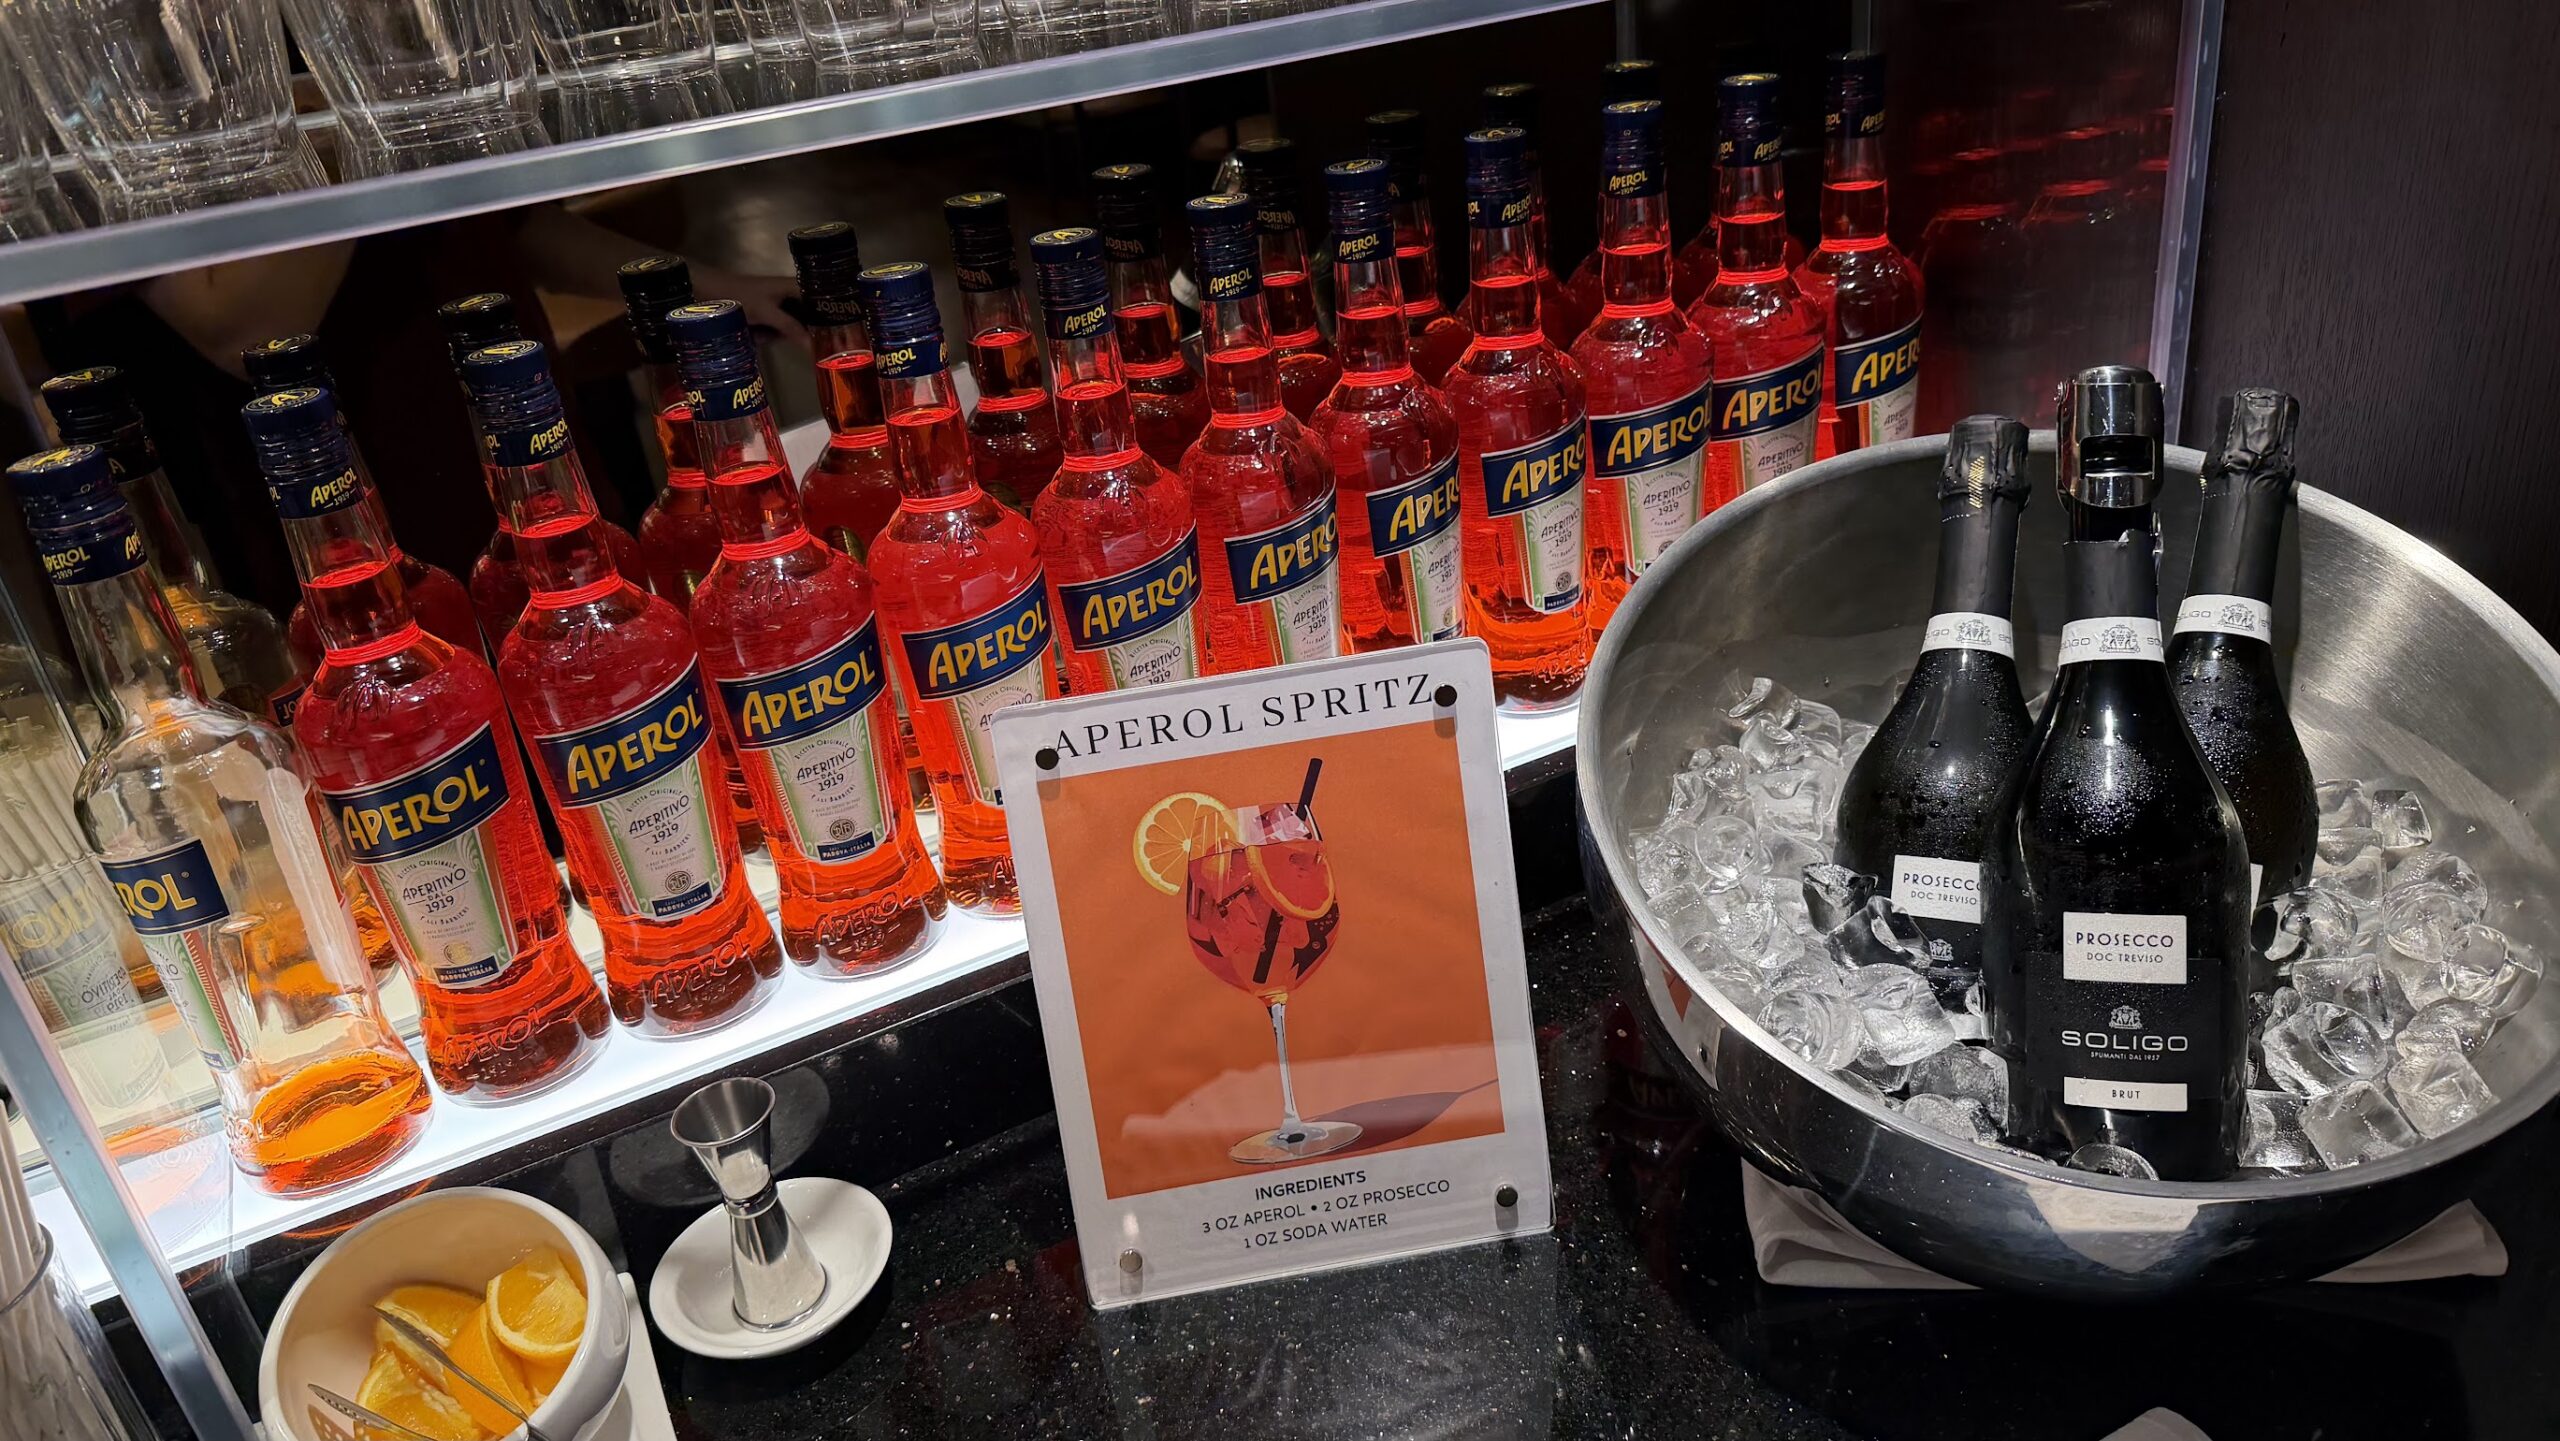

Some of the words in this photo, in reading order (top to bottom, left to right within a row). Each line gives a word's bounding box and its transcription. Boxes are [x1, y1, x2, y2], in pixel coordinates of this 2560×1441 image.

[1609, 170, 1648, 191] APEROL
[1339, 233, 1380, 257] APEROL
[1210, 268, 1253, 294] APEROL
[1064, 304, 1107, 333] APEROL
[876, 347, 916, 370] APEROL
[1851, 337, 1919, 394] APER
[530, 417, 568, 455] APEROL
[1503, 433, 1585, 503] APERO
[311, 467, 357, 508] APEROL
[1644, 480, 1690, 505] APERITIVO
[1658, 501, 1679, 516] 1919
[1250, 512, 1336, 590] APERO
[1083, 556, 1197, 638] APEROL
[1308, 616, 1327, 634] 1919
[929, 601, 1046, 688] APEROL
[1130, 646, 1181, 678] APERITIVO
[742, 651, 875, 737] APEROL
[1053, 703, 1243, 760] APEROL
[1263, 673, 1434, 728] SPRITZ
[567, 695, 703, 794] APEROL
[797, 747, 855, 780] APERITIVO
[821, 770, 838, 779] DAL
[818, 773, 844, 792] 1919
[343, 765, 489, 850] APEROL
[629, 795, 689, 834] APERITIVO
[652, 823, 679, 844] 1919
[655, 821, 671, 831] DAL
[115, 873, 197, 919] ROL
[403, 868, 466, 901] APERITIVO
[427, 892, 447, 901] DAL
[1911, 891, 1934, 900] DOC
[1938, 893, 1977, 905] TREVISO
[425, 896, 454, 913] 1919
[2076, 932, 2174, 948] PROSECCO
[2087, 952, 2113, 962] DOC
[2119, 953, 2163, 963] TREVISO
[2061, 1030, 2188, 1052] SOLIGO
[2091, 1051, 2127, 1060] SPUMANTI
[2129, 1053, 2142, 1061] DAL
[2112, 1090, 2140, 1099] BRUT
[1255, 1170, 1366, 1200] INGREDIENTS
[1202, 1222, 1211, 1234] 3
[1215, 1215, 1239, 1231] OZ
[1243, 1203, 1305, 1226] APEROL
[1324, 1201, 1332, 1212] 2
[1336, 1194, 1359, 1209] OZ
[1363, 1179, 1450, 1206] PROSECCO
[1244, 1238, 1251, 1248] 1
[1255, 1231, 1278, 1247] OZ
[1283, 1223, 1327, 1242] SODA
[1330, 1213, 1388, 1233] WATER
